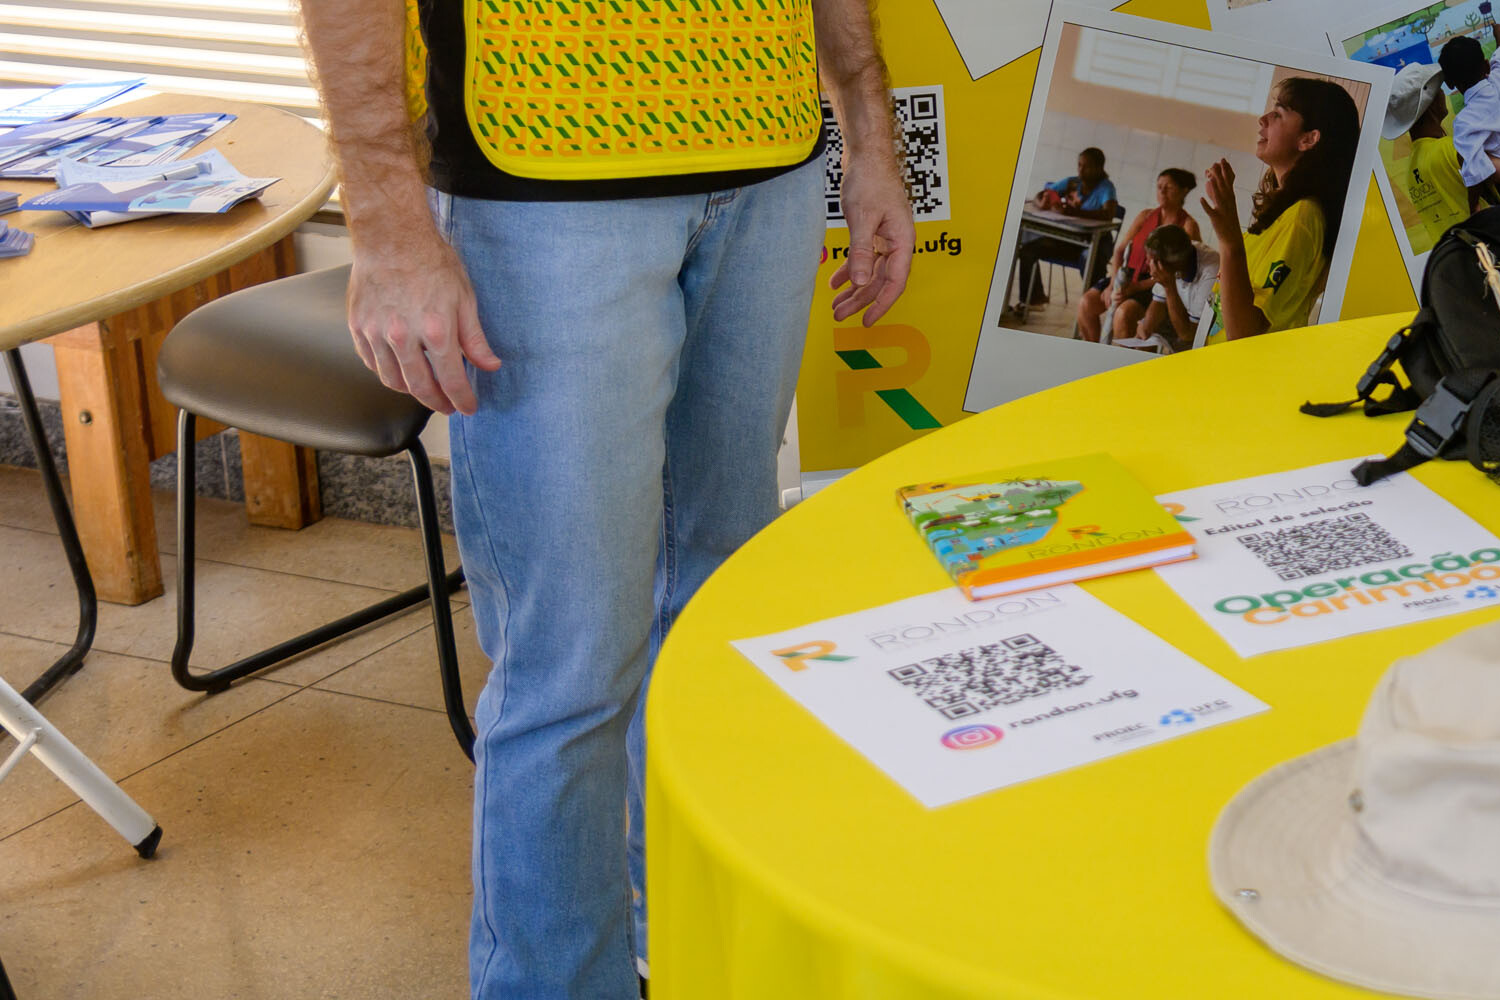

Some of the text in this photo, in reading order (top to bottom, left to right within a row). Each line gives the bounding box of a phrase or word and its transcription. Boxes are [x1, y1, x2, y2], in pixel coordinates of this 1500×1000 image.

[832, 232, 962, 260] ro.ufg
[1216, 477, 1391, 514] RONDO
[1204, 498, 1374, 536] Edital de seleção
[1026, 527, 1165, 559] RONDON
[868, 592, 1062, 649] RONDON
[1009, 687, 1139, 729] rondon.ufg
